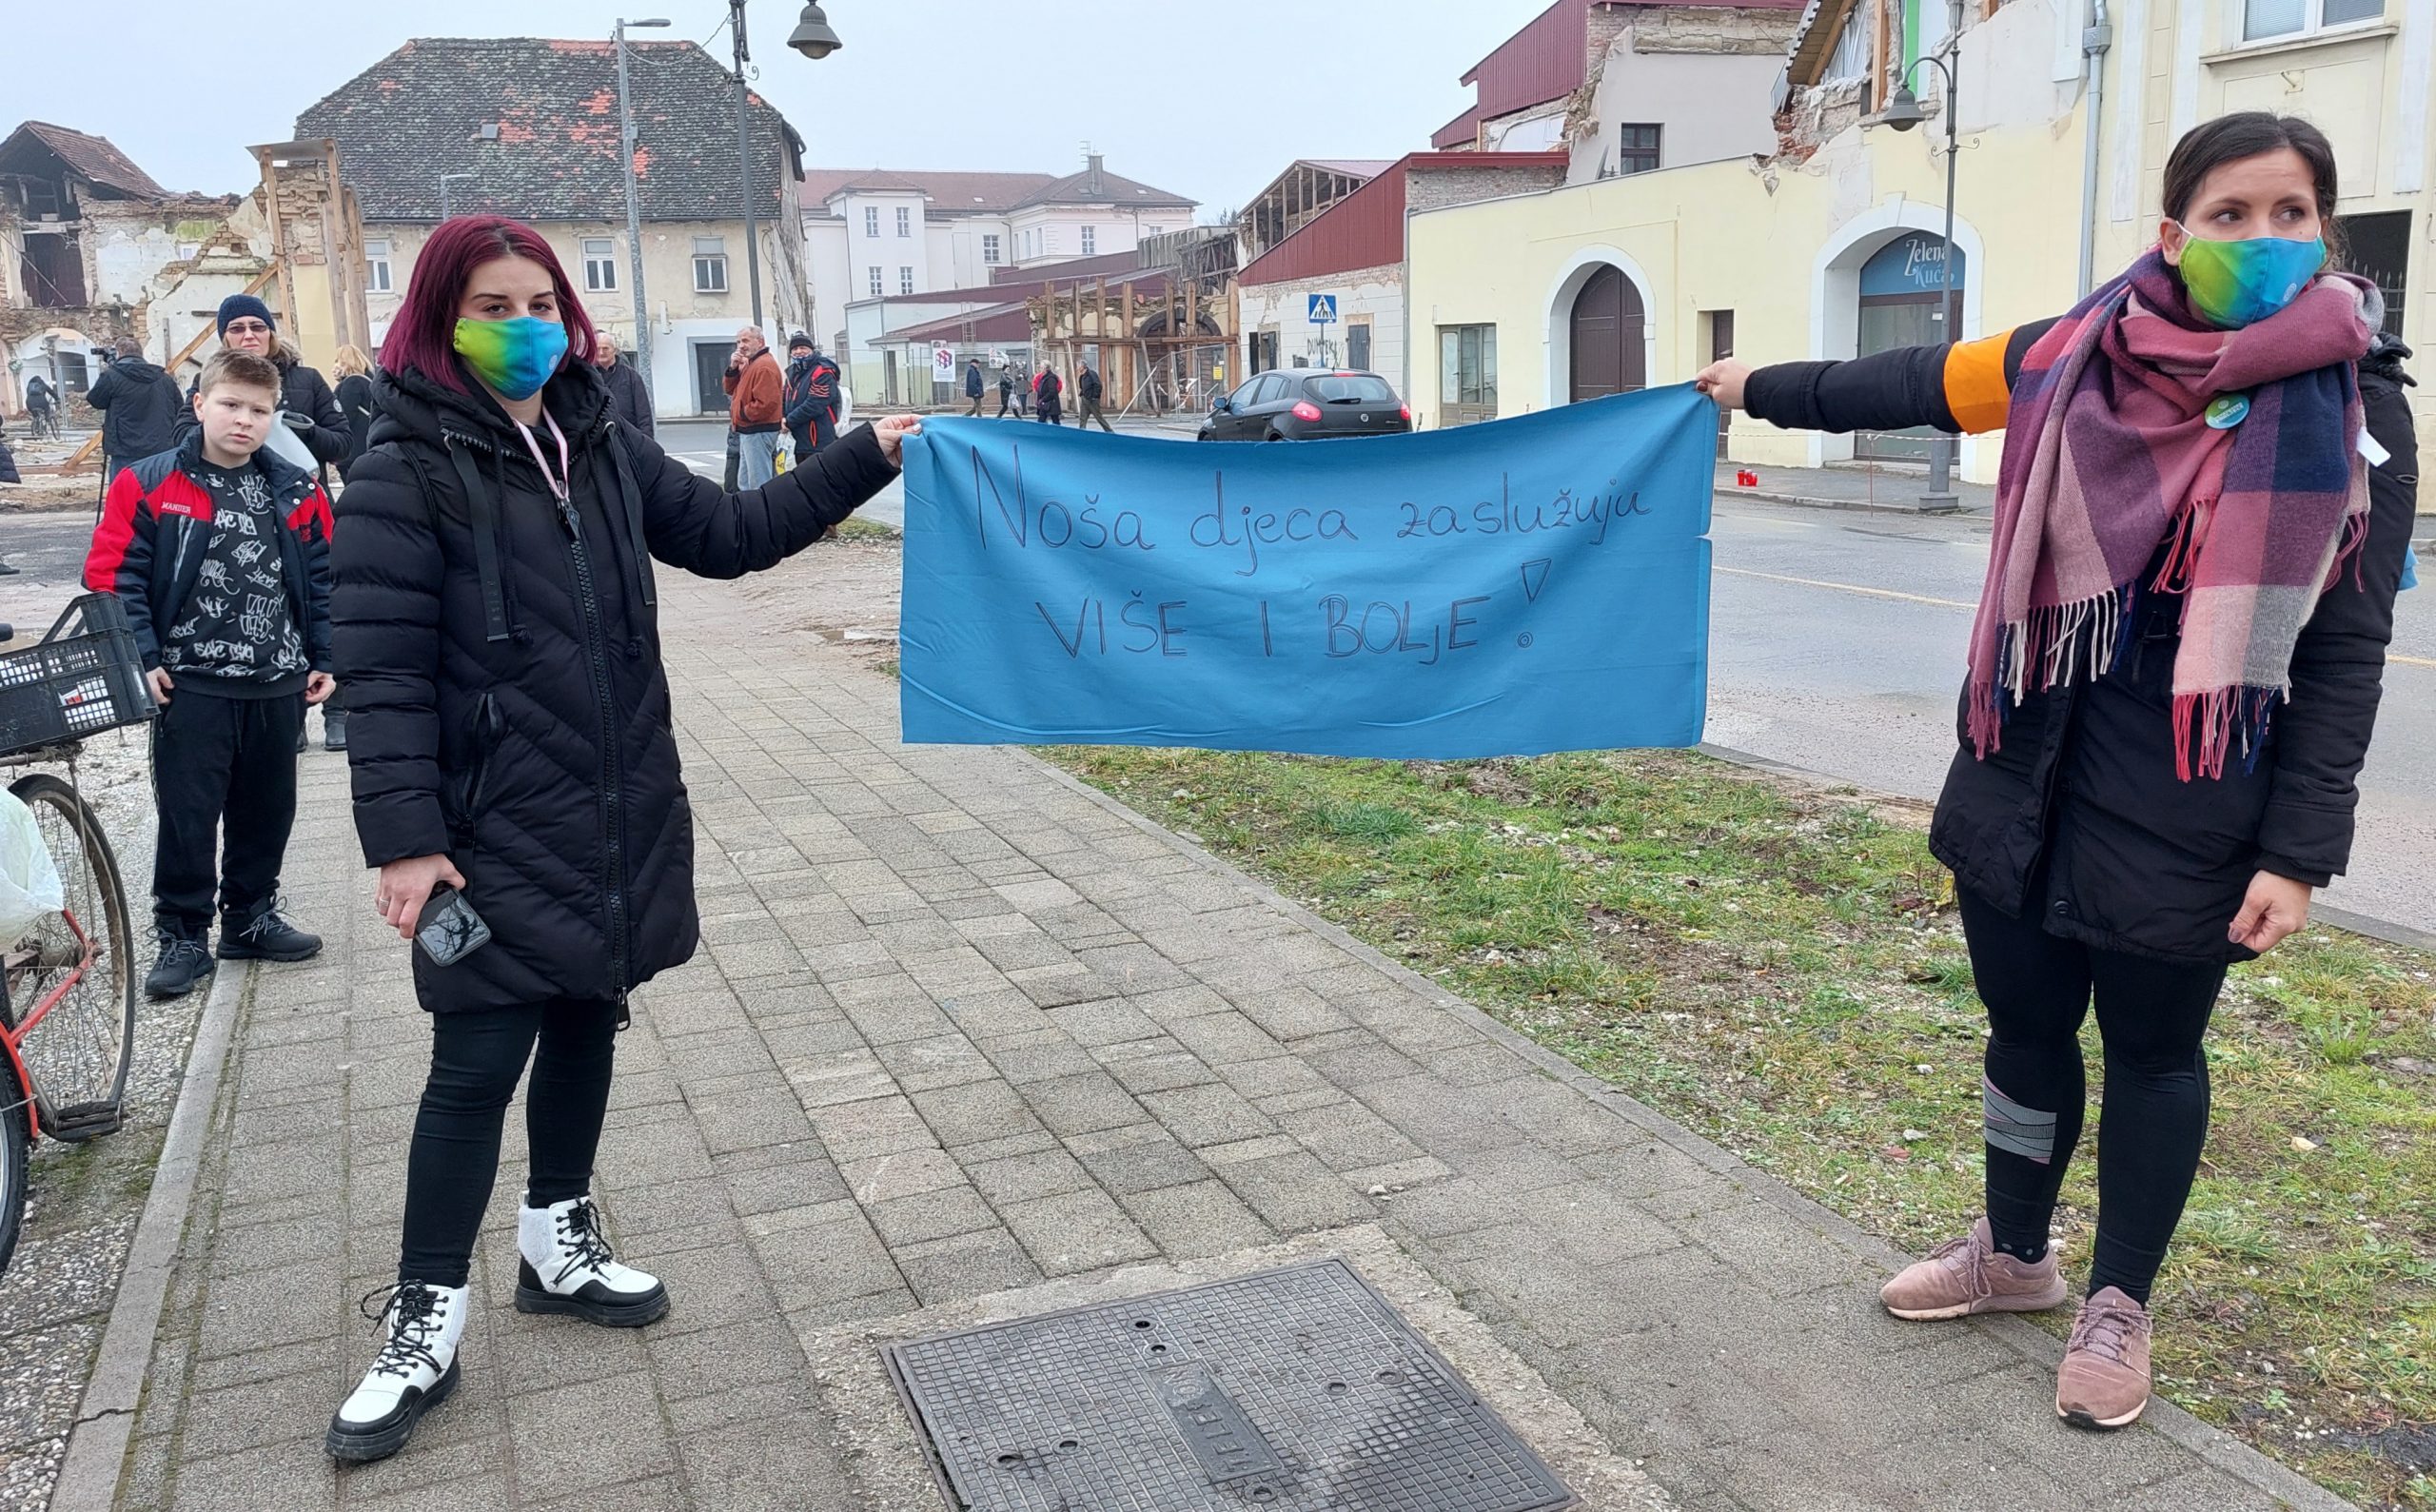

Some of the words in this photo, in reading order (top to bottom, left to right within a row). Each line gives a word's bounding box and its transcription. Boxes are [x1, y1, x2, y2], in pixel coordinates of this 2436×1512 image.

[1190, 470, 1358, 577] djeca
[1397, 472, 1652, 545] zaslužuju
[1035, 590, 1188, 658] VIŠE
[1261, 600, 1272, 657] I
